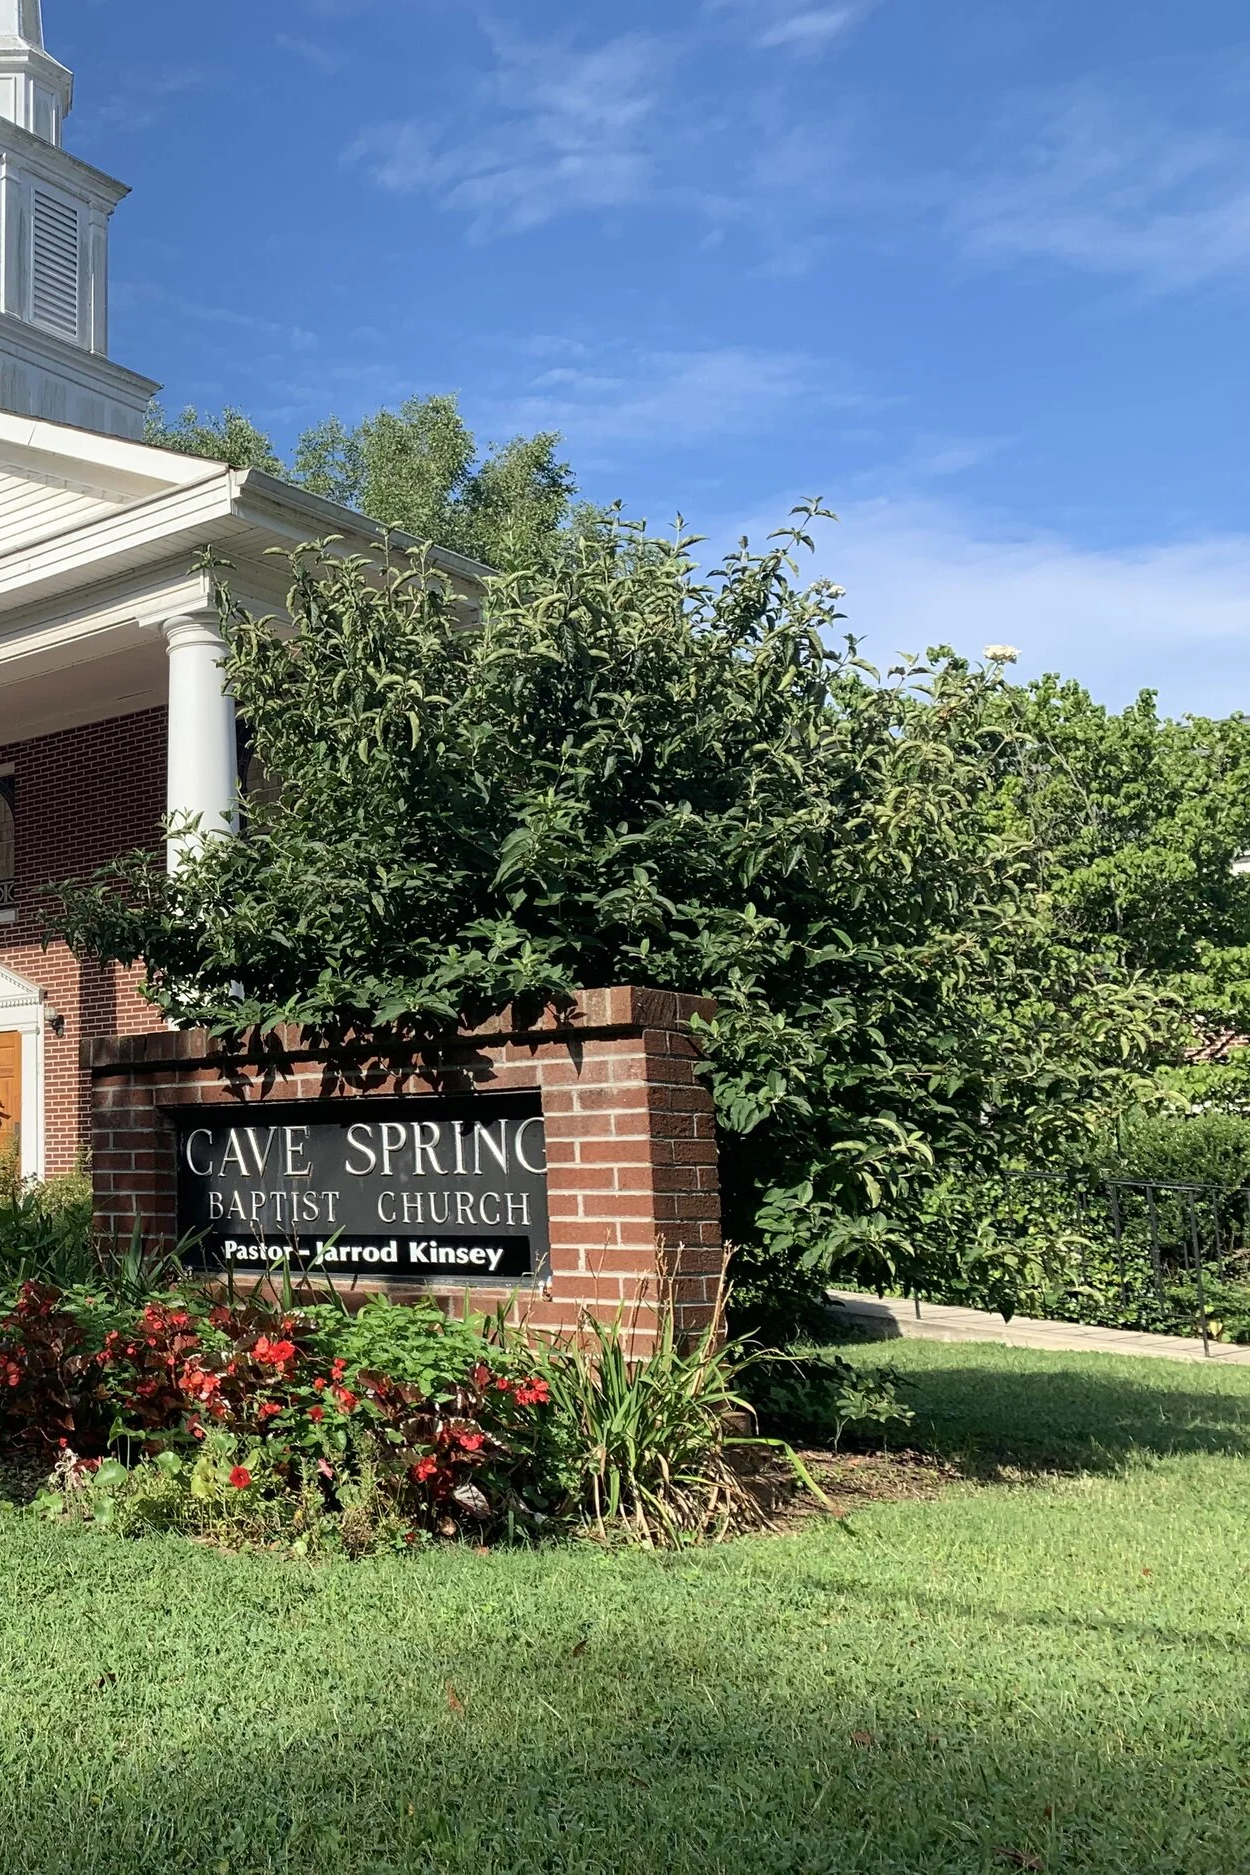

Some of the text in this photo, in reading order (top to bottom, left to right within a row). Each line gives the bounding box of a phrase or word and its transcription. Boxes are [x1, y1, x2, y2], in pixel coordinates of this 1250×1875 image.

[186, 1125, 314, 1178] CAVE
[208, 1190, 531, 1226] BAPTIST CHURCH
[409, 1240, 504, 1271] Kinsey
